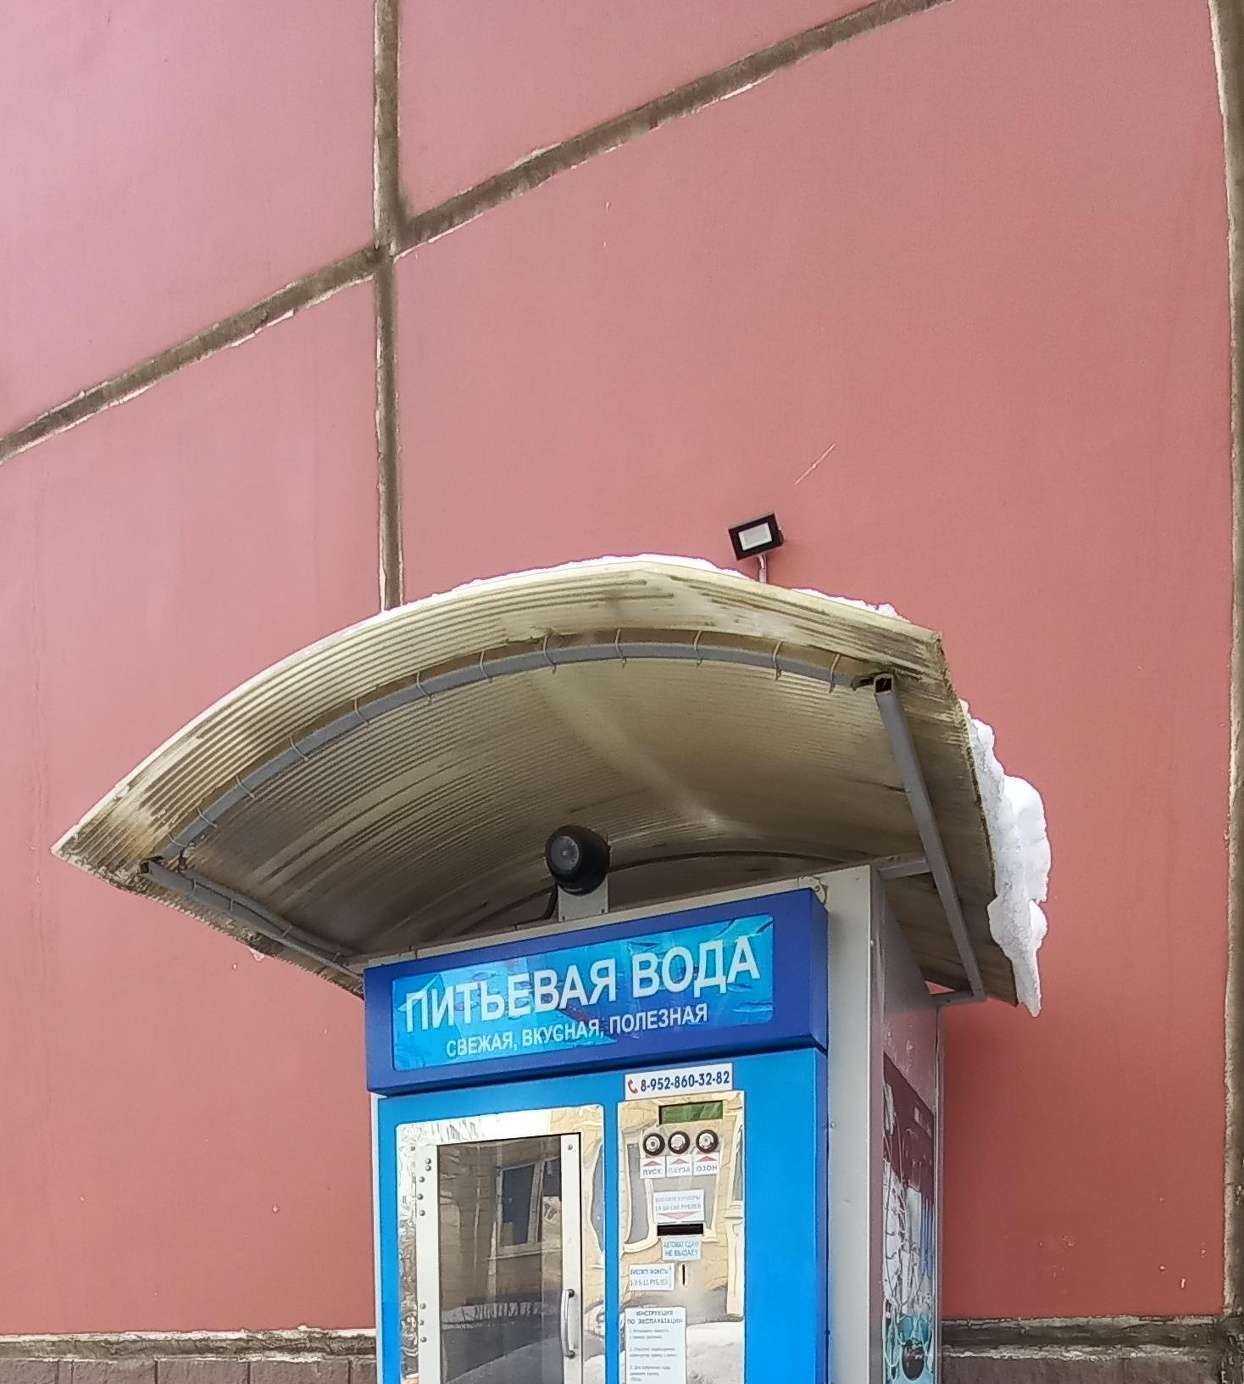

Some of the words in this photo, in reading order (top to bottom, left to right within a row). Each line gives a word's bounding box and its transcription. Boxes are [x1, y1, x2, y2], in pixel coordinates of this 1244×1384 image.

[406, 959, 617, 1032] ПИТЬЕВАЯ
[632, 935, 761, 998] ВОДА
[446, 1032, 518, 1058] СВЕЖАЯ,
[522, 1019, 604, 1047] ВКУСНАЯ,
[609, 1003, 708, 1035] ПОЛЕЗНАЯ
[640, 1070, 730, 1092] 8-952-860-32-82
